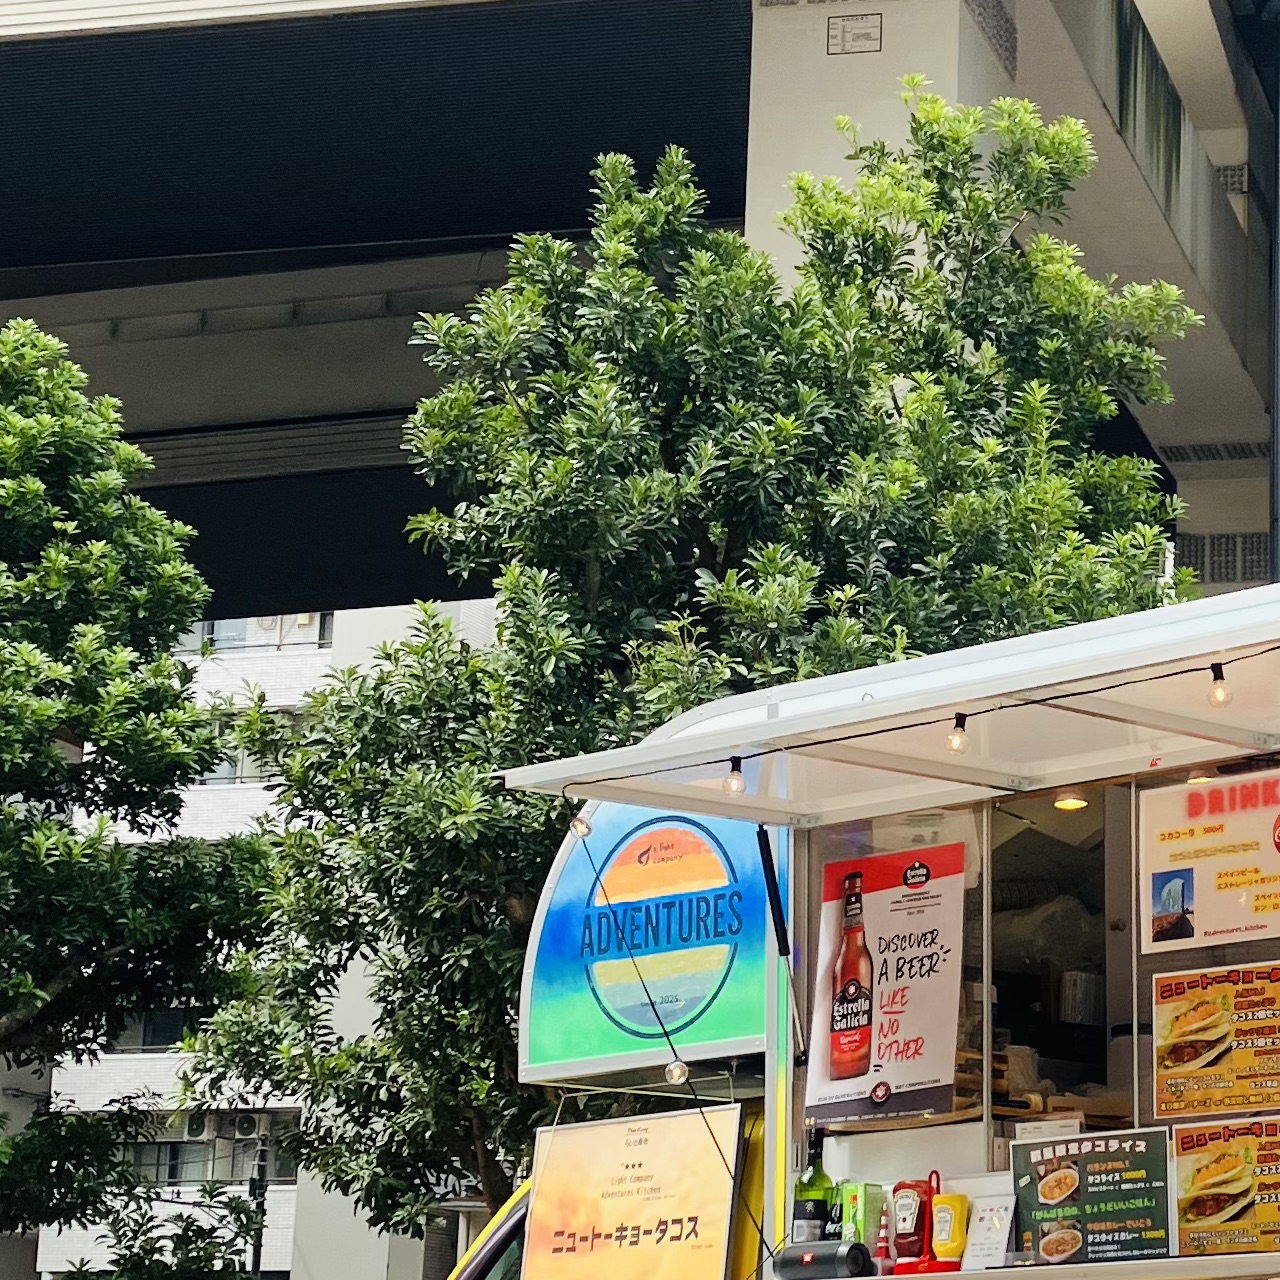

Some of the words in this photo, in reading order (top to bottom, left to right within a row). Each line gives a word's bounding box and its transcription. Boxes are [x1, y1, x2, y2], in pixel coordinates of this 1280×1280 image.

[652, 854, 683, 865] company
[581, 891, 743, 958] ADVENTURES
[878, 928, 939, 954] DISCOVER
[878, 958, 889, 985] A
[896, 952, 941, 982] BEER
[833, 998, 870, 1017] Estrella
[879, 986, 911, 1010] LIKE
[833, 1014, 868, 1031] Galicia
[878, 1017, 900, 1041] NO
[877, 1036, 925, 1064] OTHER
[630, 1174, 654, 1184] Company
[601, 1189, 634, 1199] Adventures
[637, 1186, 661, 1196] Kitchen
[552, 1216, 699, 1254] ニュートーキョータコス
